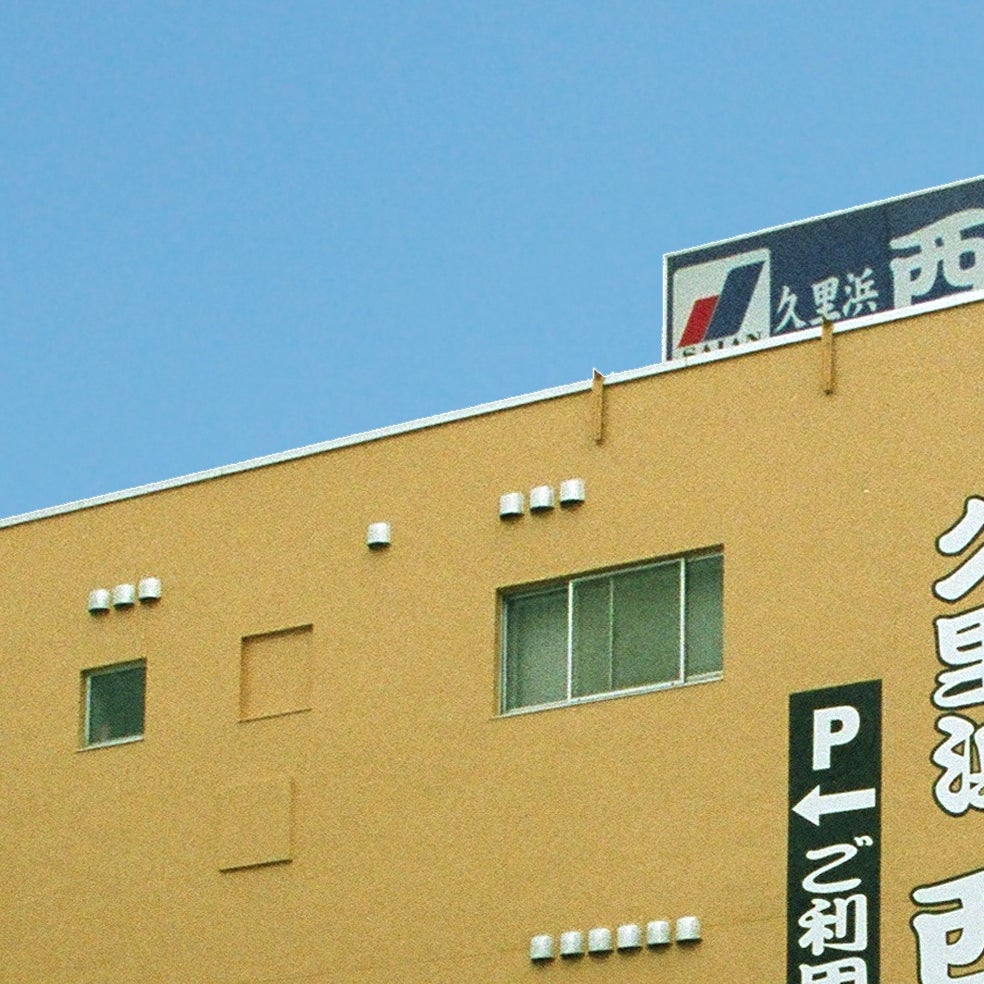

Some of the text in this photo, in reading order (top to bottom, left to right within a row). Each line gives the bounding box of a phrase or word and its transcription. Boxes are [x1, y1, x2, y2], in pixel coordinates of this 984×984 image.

[775, 266, 880, 332] 久里浜
[812, 704, 861, 771] P
